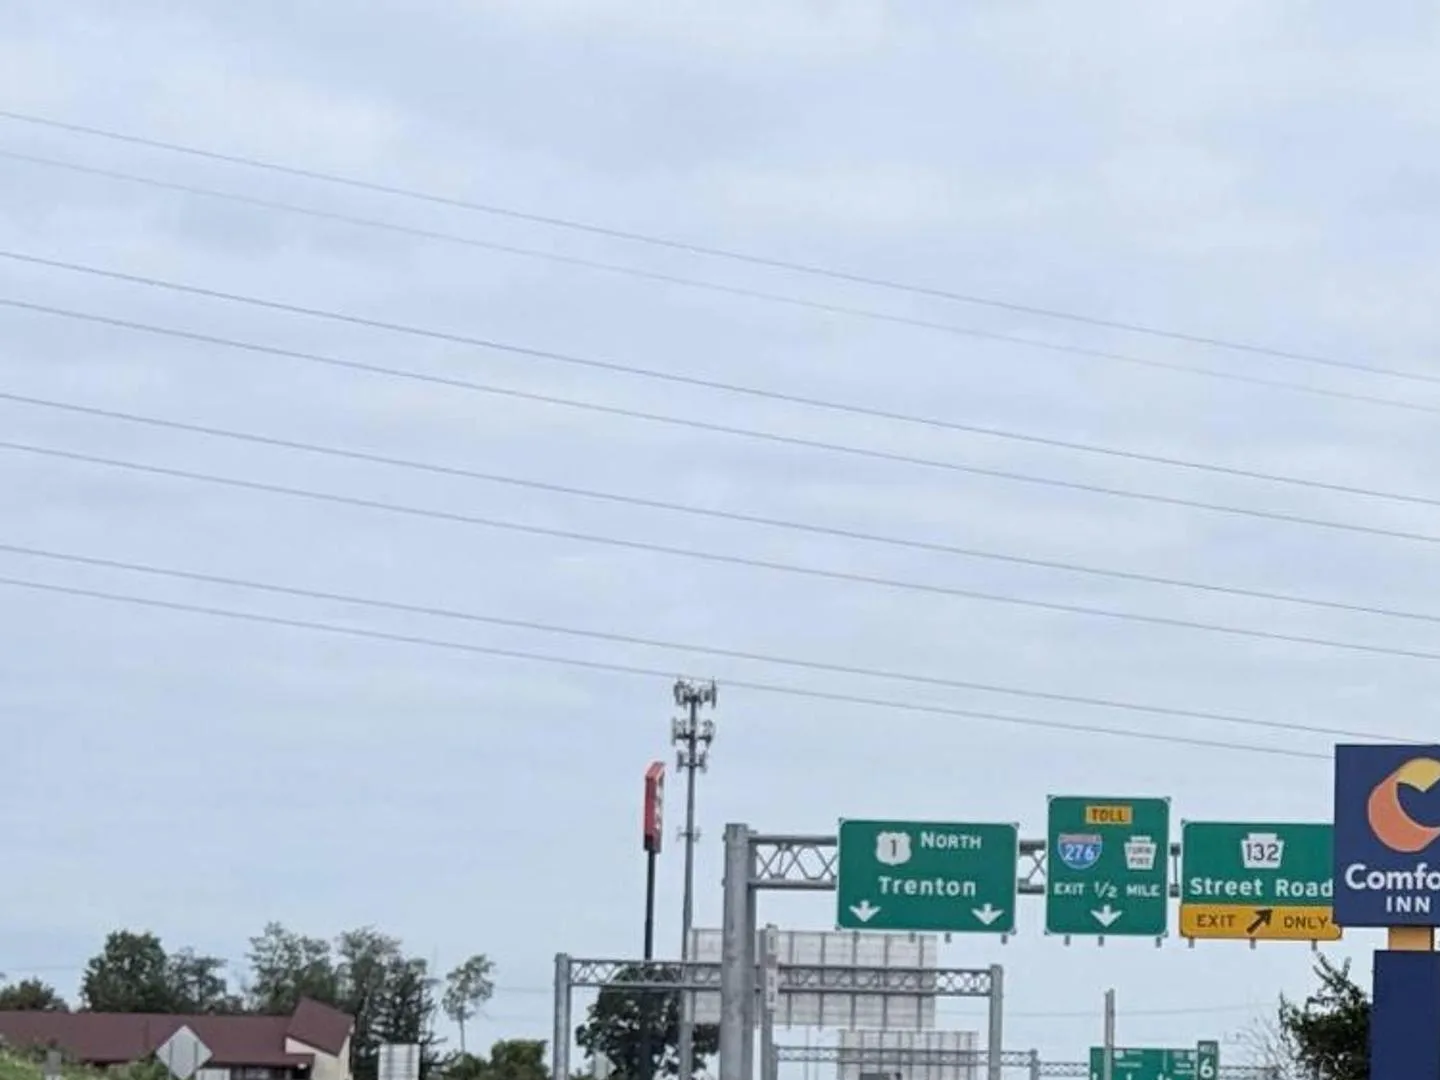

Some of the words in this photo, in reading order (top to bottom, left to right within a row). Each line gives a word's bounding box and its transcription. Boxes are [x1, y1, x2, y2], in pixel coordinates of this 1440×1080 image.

[1092, 807, 1126, 822] TOLL
[890, 839, 897, 857] 1
[920, 831, 982, 850] NORTH
[1063, 844, 1095, 861] 276
[1246, 843, 1279, 862] 132
[878, 876, 976, 897] Trenton
[1054, 882, 1085, 896] EXIT
[1126, 883, 1160, 898] MILE
[1189, 877, 1263, 897] Street
[1275, 878, 1333, 897] Road
[1385, 896, 1431, 914] INN
[1196, 914, 1236, 928] EXIT
[1283, 915, 1329, 930] ONLY
